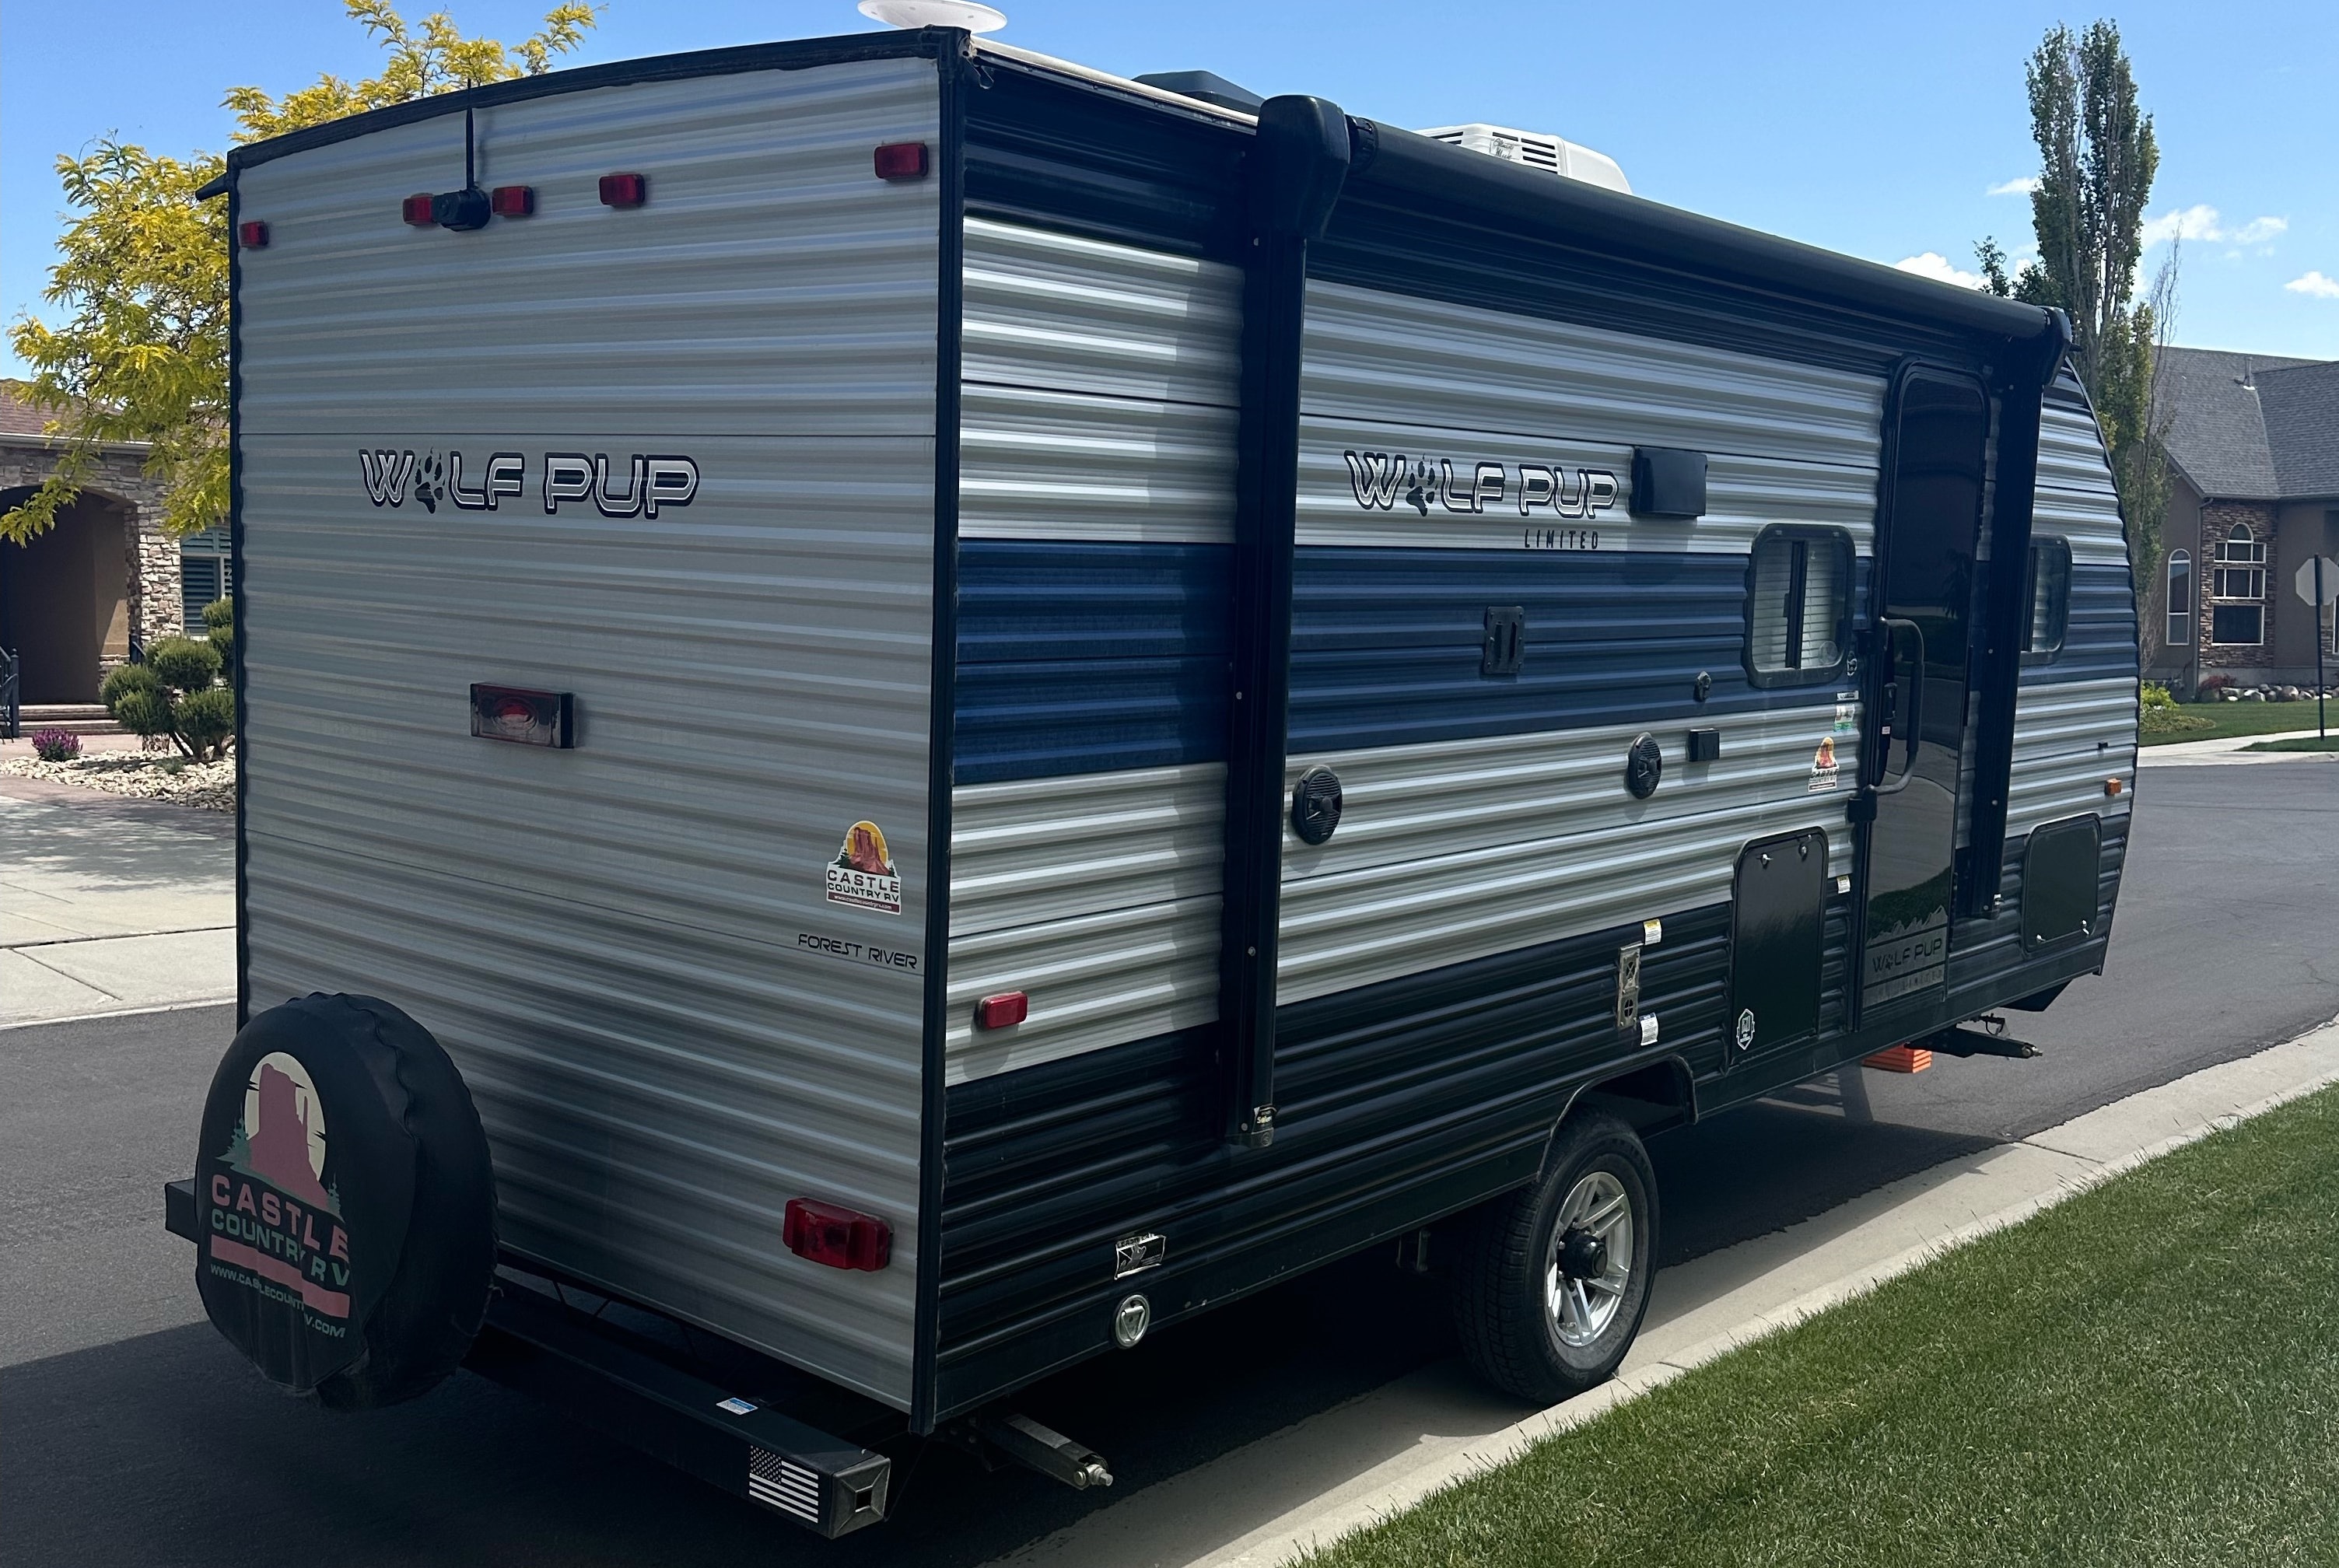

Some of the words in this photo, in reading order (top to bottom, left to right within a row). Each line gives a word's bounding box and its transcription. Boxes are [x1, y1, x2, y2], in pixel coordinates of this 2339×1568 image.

[544, 453, 699, 520] PUP
[1518, 462, 1619, 520] PUP
[1525, 528, 1598, 550] LIMITED
[827, 869, 899, 894] CASTLE
[827, 882, 881, 899] COUNTRY
[884, 893, 899, 902] RV
[798, 933, 863, 957] FOREST
[868, 947, 918, 969] RIVER
[1914, 937, 1942, 961] PUP
[212, 1174, 350, 1264] CASTLE
[310, 1255, 350, 1286] RV
